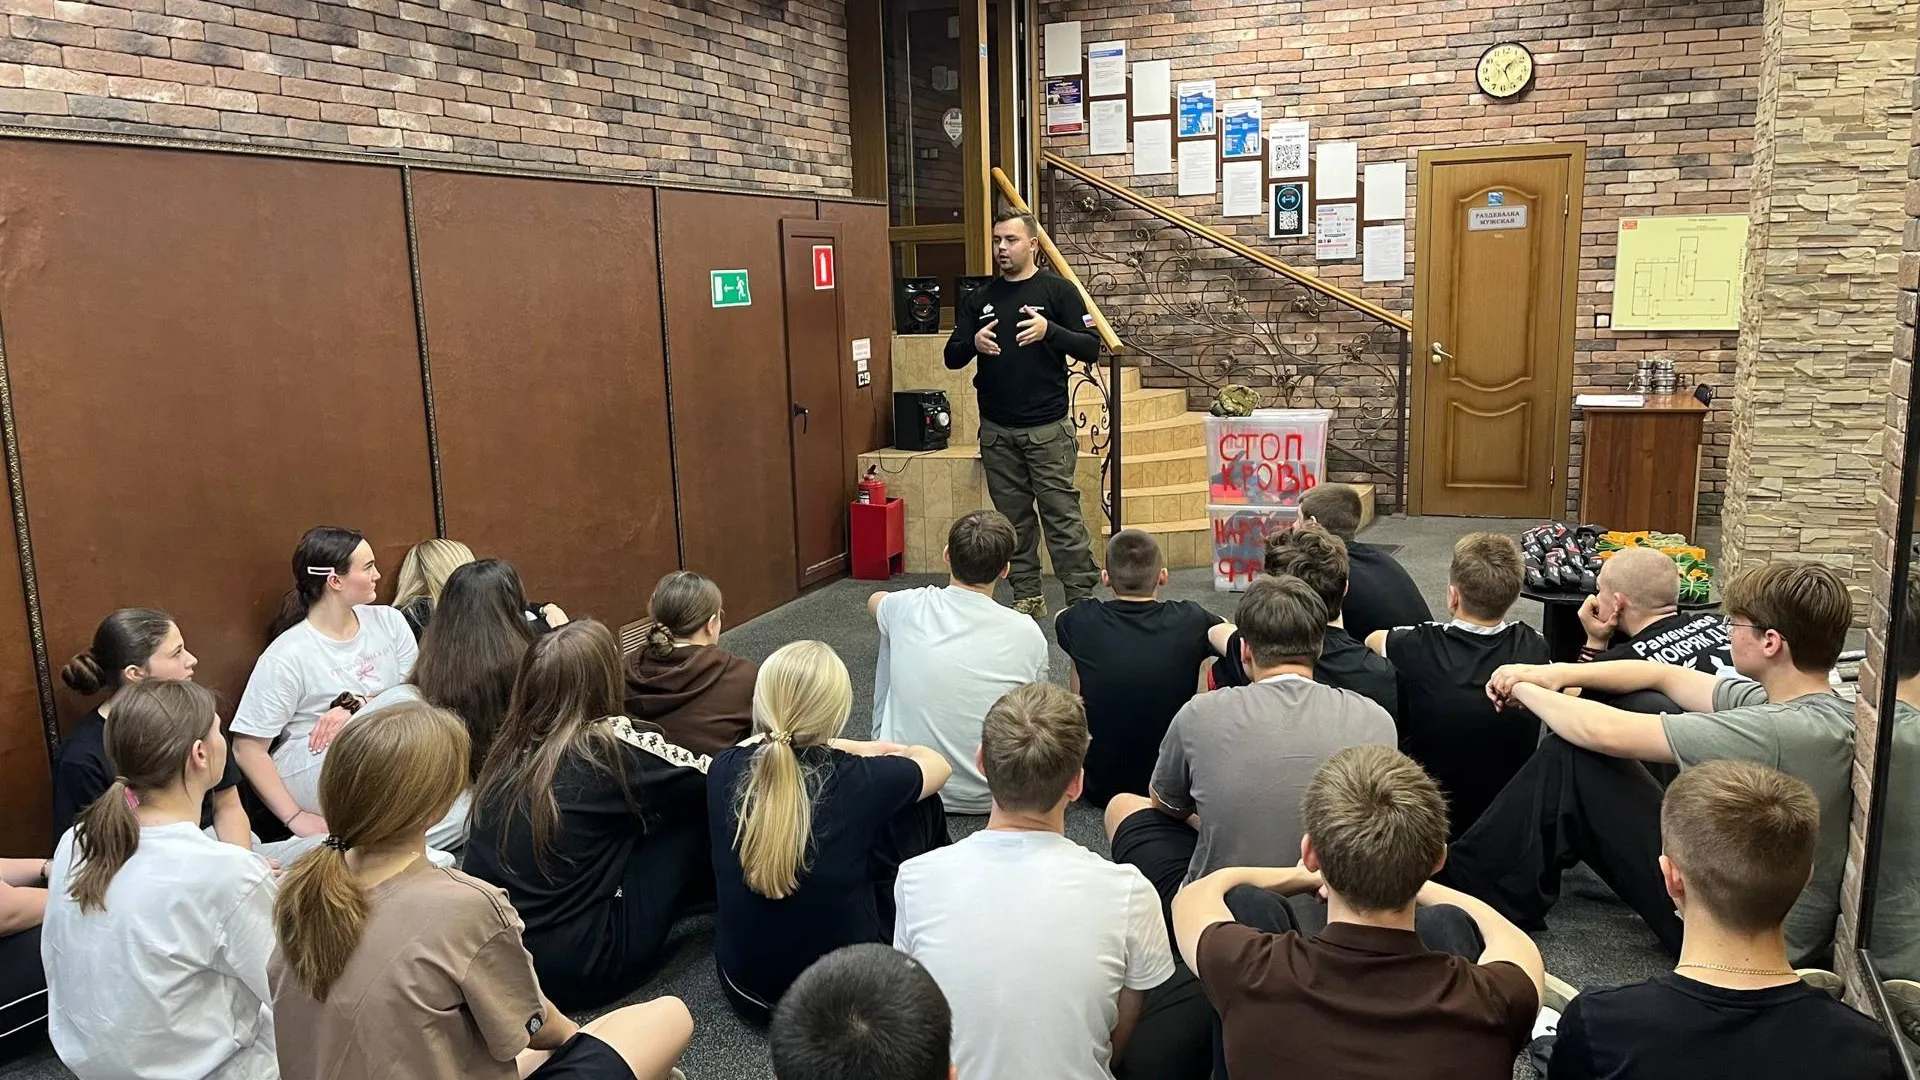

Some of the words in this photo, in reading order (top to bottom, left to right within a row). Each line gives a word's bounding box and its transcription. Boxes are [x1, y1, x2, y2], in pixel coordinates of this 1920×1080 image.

[1476, 211, 1520, 219] РАЗДЕВАЛКА
[1220, 432, 1302, 461] СТОП
[1221, 463, 1316, 493] КРОВЬ
[1214, 517, 1271, 547] НАРО
[1219, 557, 1265, 582] ФР
[1632, 615, 1718, 657] Раменское
